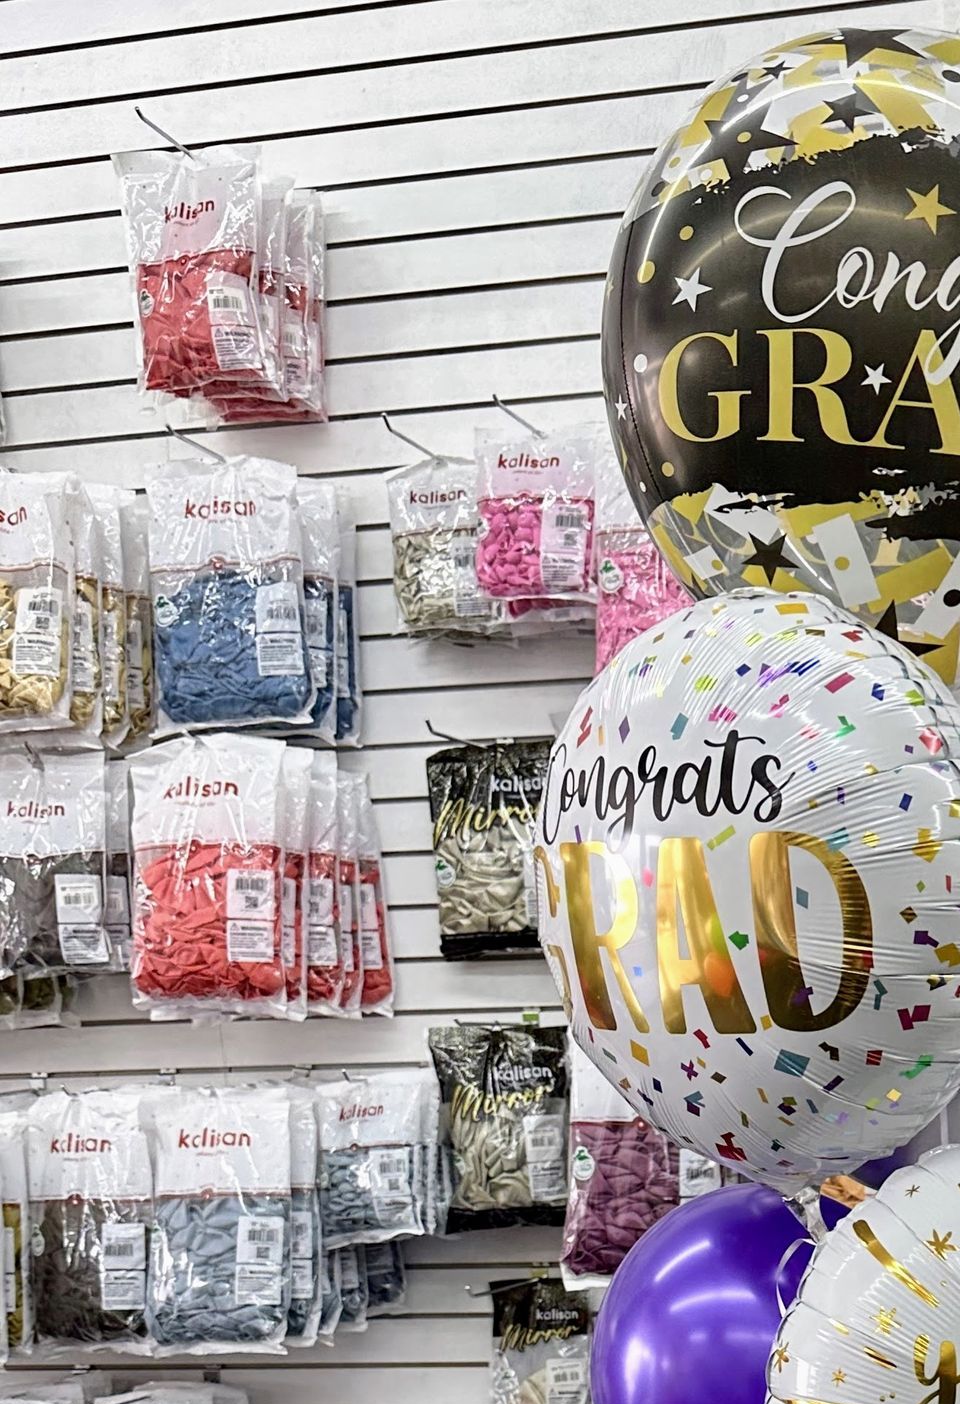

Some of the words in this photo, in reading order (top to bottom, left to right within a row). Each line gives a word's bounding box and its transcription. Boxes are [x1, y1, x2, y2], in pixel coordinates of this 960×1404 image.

[164, 200, 215, 223] kalisan
[498, 453, 561, 470] kalisan
[410, 489, 466, 505] kalisan
[184, 496, 257, 520] kaisan
[164, 776, 239, 800] kalisan
[491, 775, 546, 793] kalisa
[543, 730, 796, 853] Congrats
[7, 801, 65, 819] kalisan
[434, 799, 538, 850] Mirro
[493, 1065, 552, 1081] kalisan
[452, 1079, 554, 1122] Mirror
[338, 1103, 385, 1122] kalisan
[50, 1133, 111, 1154] kalisan
[178, 1128, 252, 1149] kalisan
[536, 1308, 579, 1321] kalisan
[500, 1323, 580, 1353] Mirror
